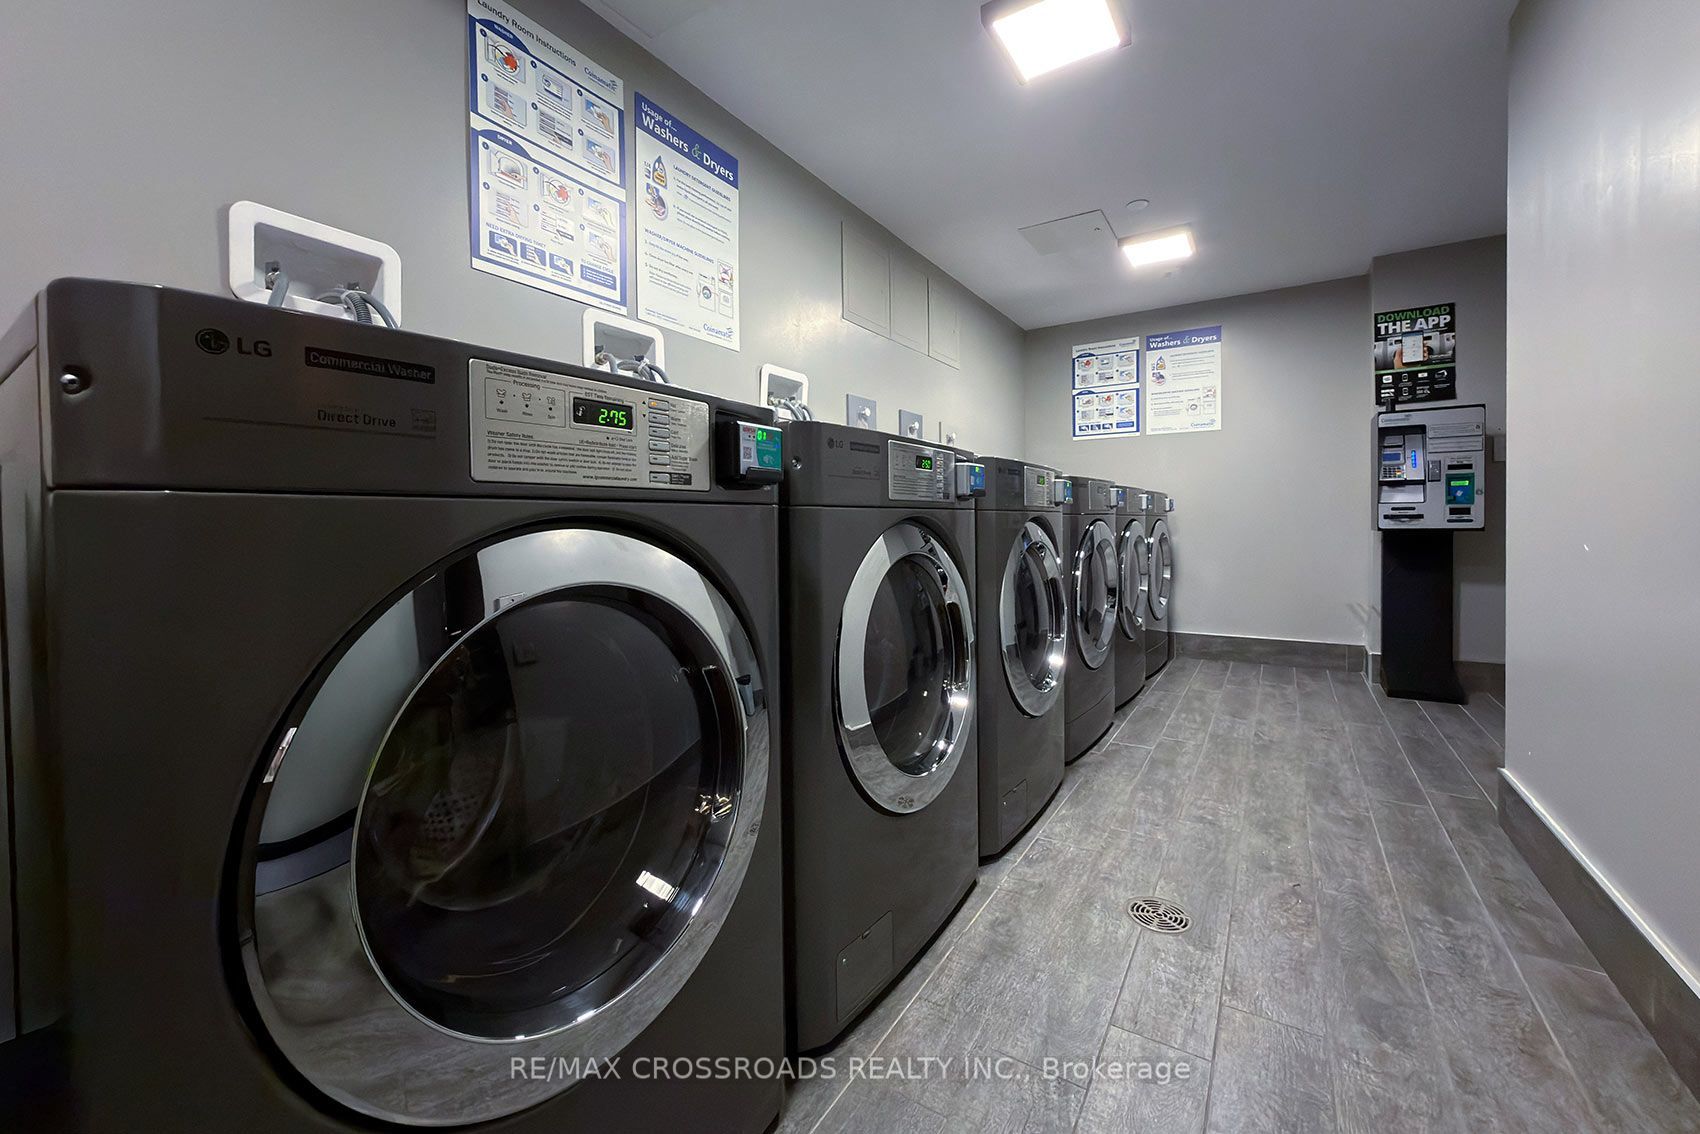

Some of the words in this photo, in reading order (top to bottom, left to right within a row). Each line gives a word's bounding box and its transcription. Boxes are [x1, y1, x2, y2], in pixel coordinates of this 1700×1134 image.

[477, 0, 510, 24] Laundry
[511, 19, 535, 40] Room
[535, 33, 577, 67] Instructions
[641, 101, 663, 122] Usage
[641, 112, 689, 153] Washers
[691, 143, 702, 160] &
[703, 152, 734, 181] Dryers
[1377, 306, 1450, 323] DOWNLOAD
[1377, 320, 1411, 335] THE
[1413, 314, 1451, 331] APP
[703, 323, 733, 338] Coinamatic
[236, 336, 273, 358] LG
[1149, 338, 1181, 349] Washers
[1183, 336, 1191, 345] &
[1191, 334, 1217, 344] Dryers
[309, 351, 386, 373] Commercial
[387, 362, 433, 381] Washer
[512, 379, 541, 390] Processing
[317, 408, 360, 425] Direct
[362, 413, 397, 428] Drive
[598, 408, 627, 427] 2.75
[835, 439, 844, 449] LG
